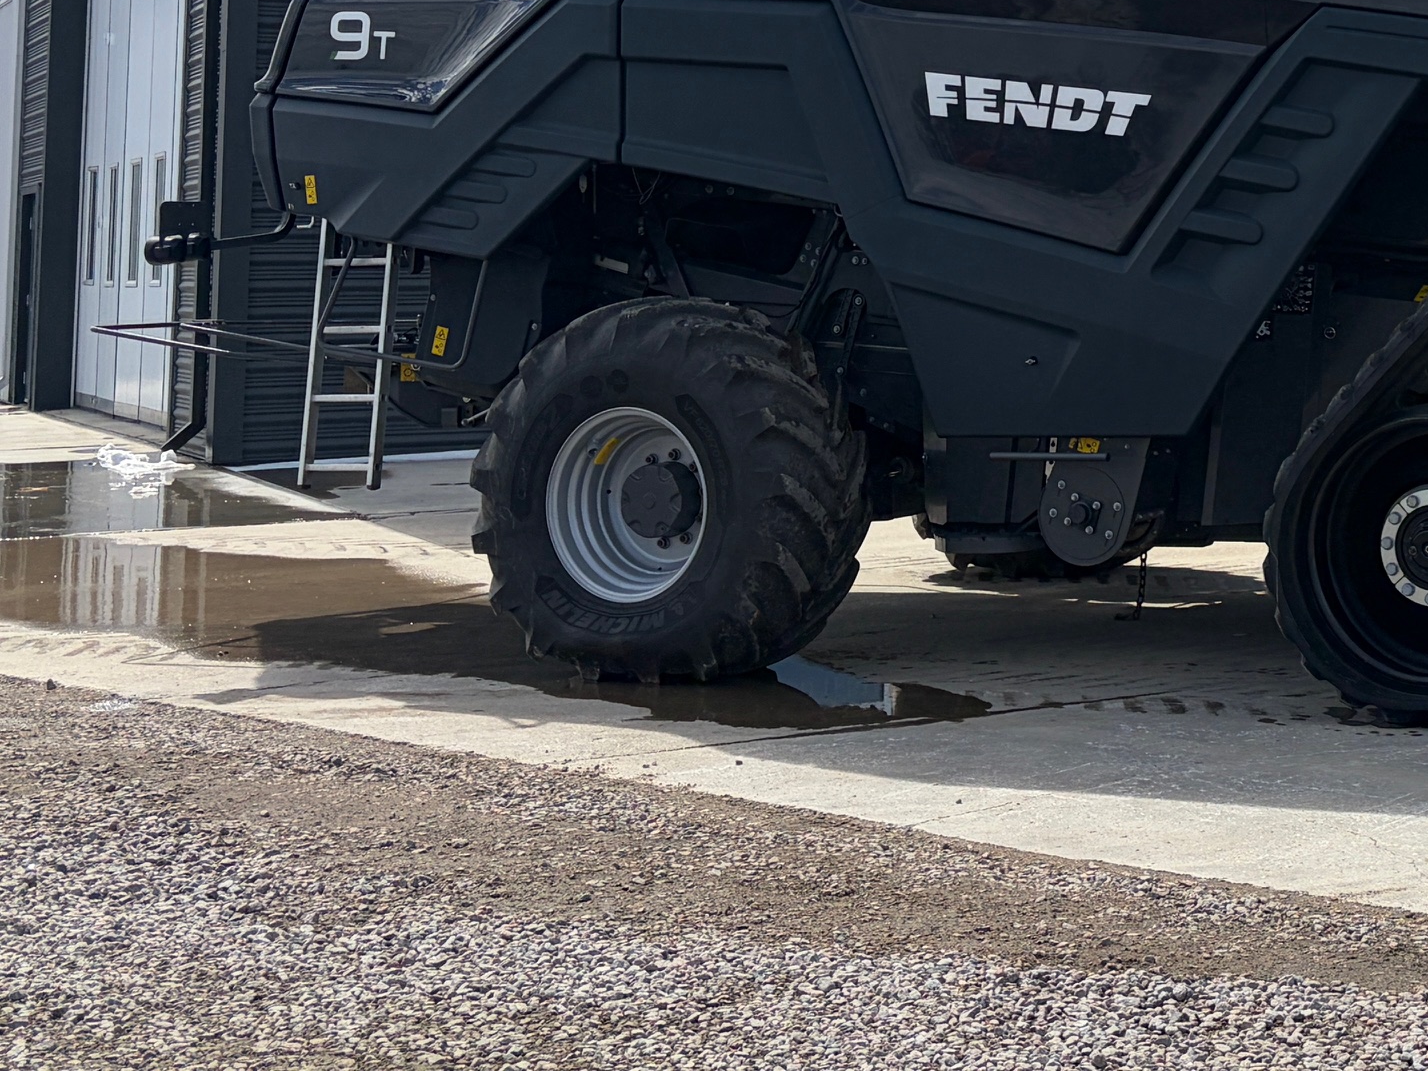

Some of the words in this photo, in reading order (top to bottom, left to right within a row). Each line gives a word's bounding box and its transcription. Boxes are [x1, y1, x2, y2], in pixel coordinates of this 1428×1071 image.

[330, 11, 396, 60] 9T
[924, 71, 1152, 137] FENDT
[541, 589, 665, 636] MICHELIN
